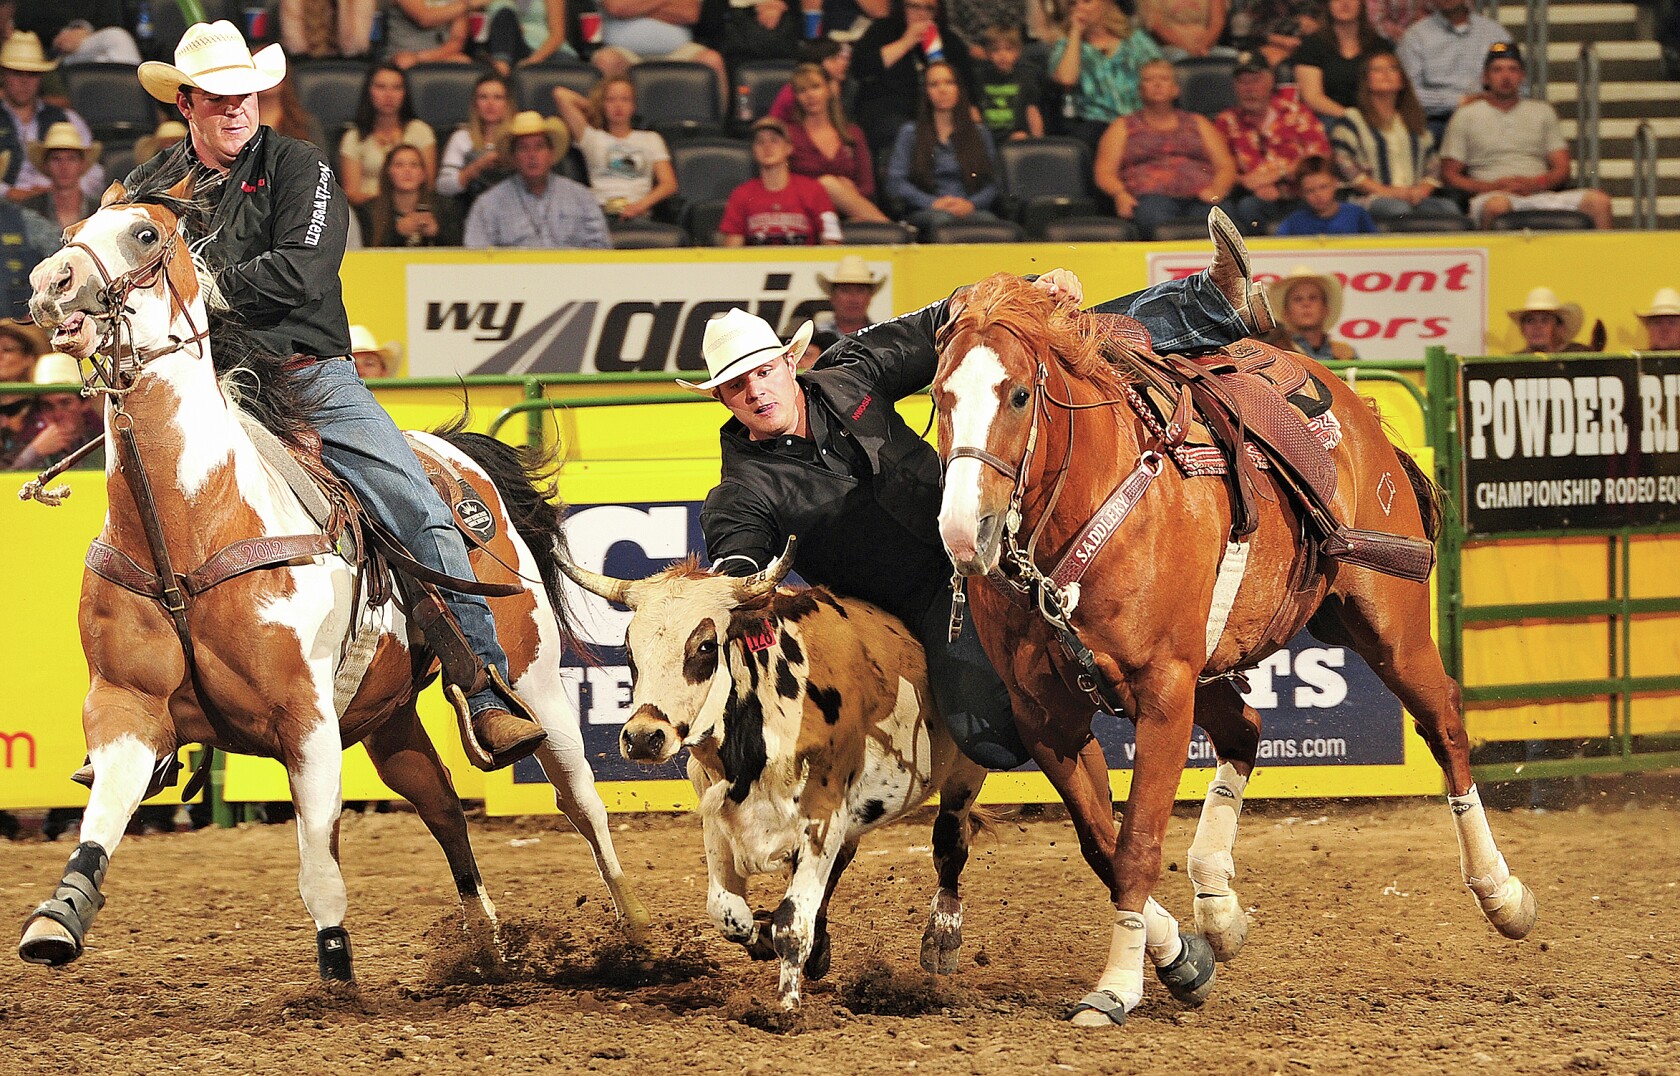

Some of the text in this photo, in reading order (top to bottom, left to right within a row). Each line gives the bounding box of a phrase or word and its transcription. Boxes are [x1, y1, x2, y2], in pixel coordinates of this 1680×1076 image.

[305, 160, 335, 246] Northwestern
[425, 301, 525, 341] wy
[1468, 373, 1680, 460] POWDER RI
[1476, 474, 1680, 510] CHAMPIONSHIP RODEO EQ
[240, 540, 288, 565] 2012
[1075, 494, 1130, 565] SADDLERY
